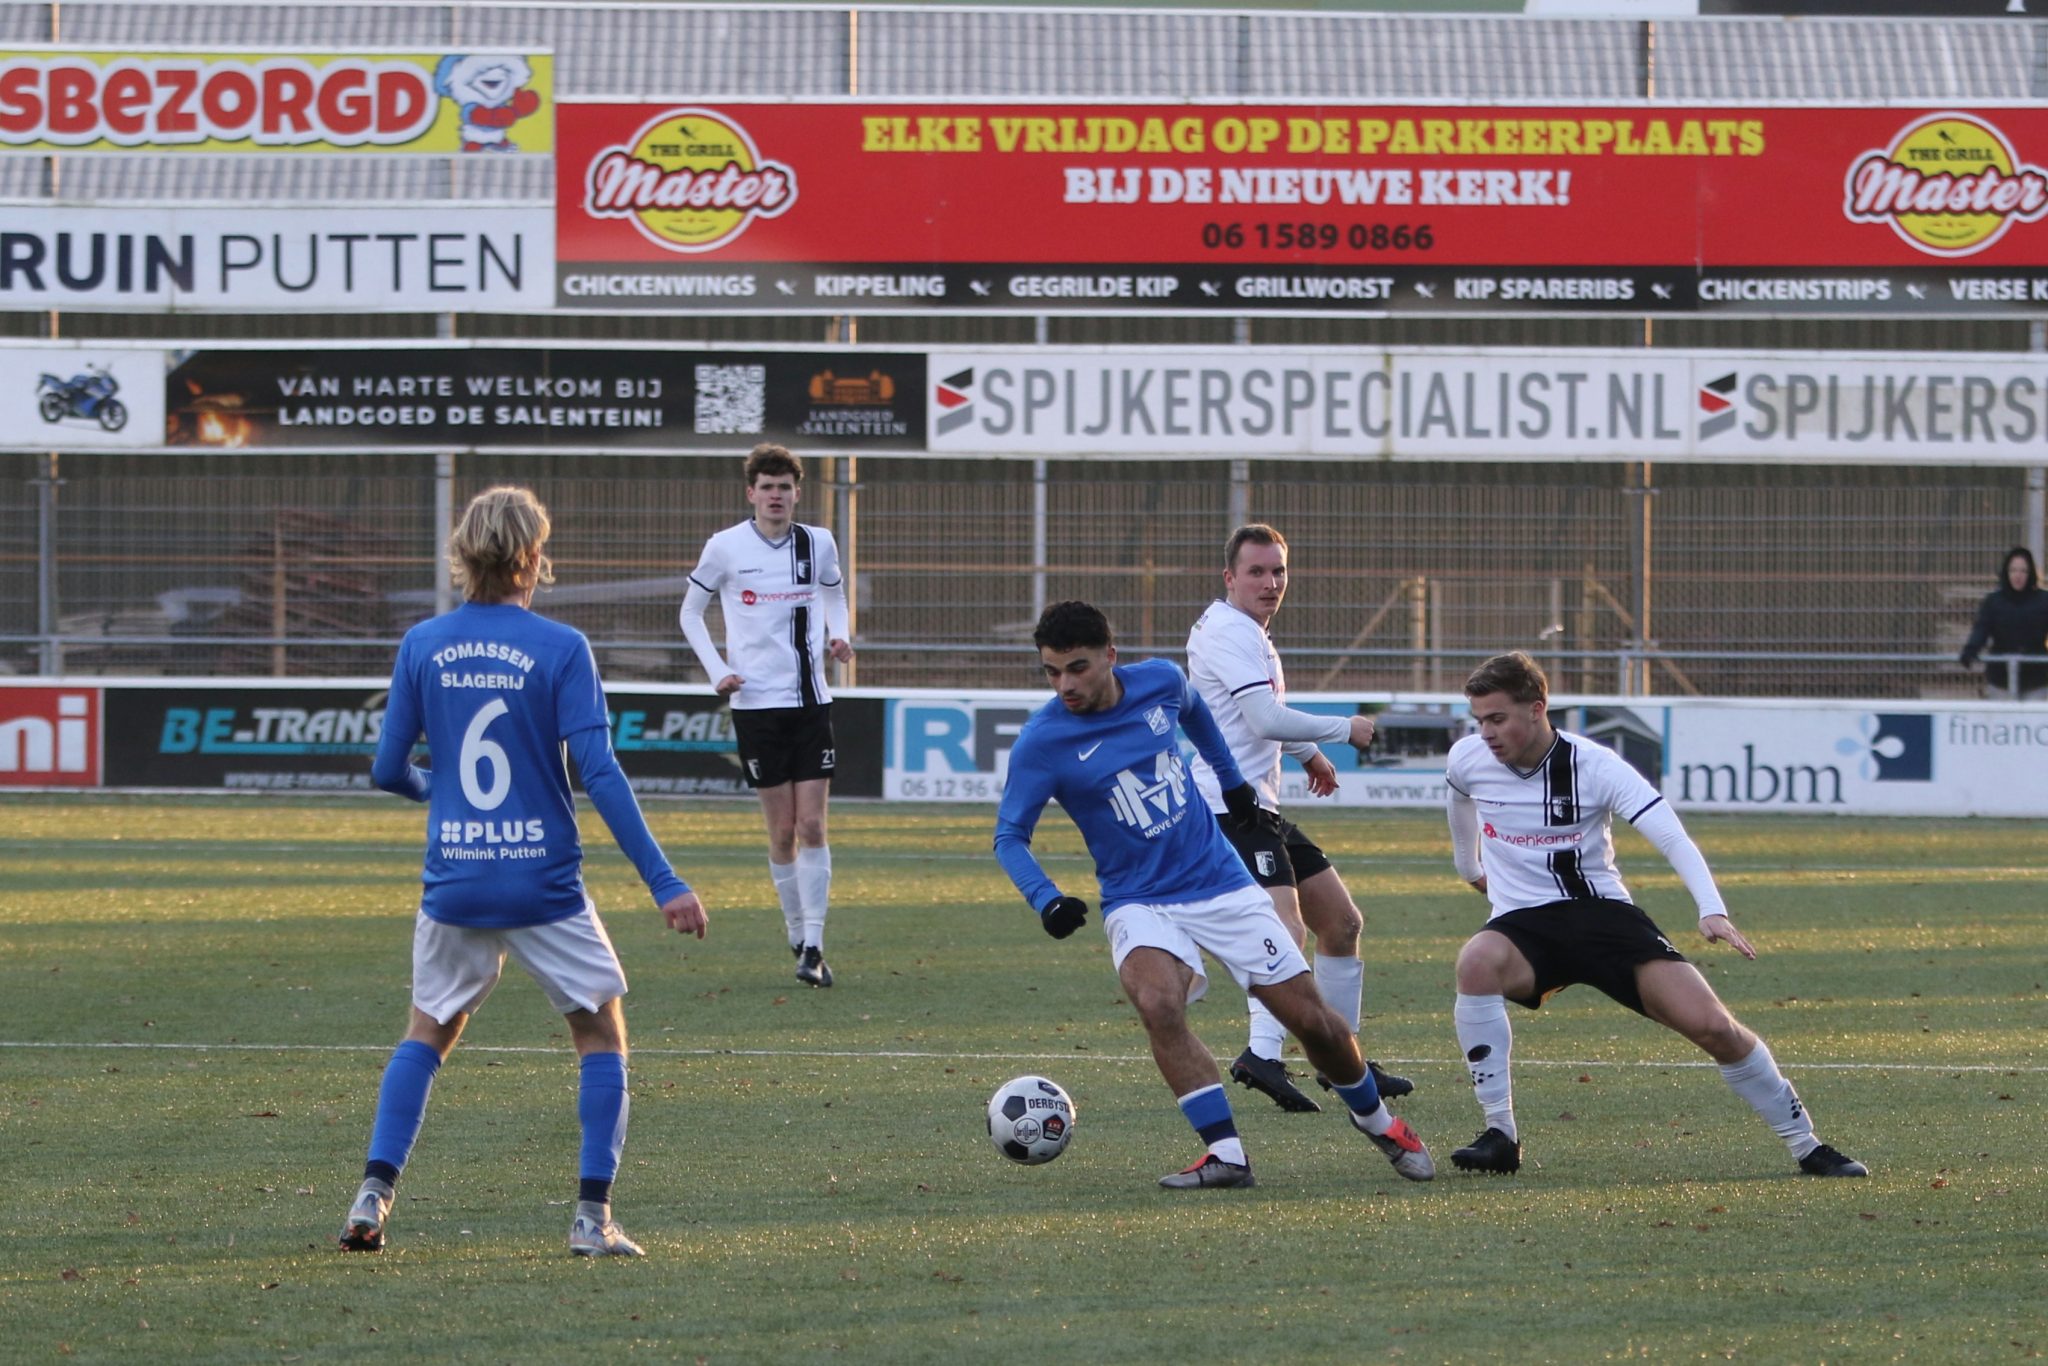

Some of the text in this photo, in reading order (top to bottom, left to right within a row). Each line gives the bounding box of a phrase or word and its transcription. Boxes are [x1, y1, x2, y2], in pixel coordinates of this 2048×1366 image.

[862, 117, 1766, 156] ELKE VRIJDAG OP DE PARKEERPLAATS
[649, 145, 735, 158] THE GRILL
[1908, 149, 1996, 162] THE GRILL
[594, 154, 787, 208] Master
[1063, 167, 1571, 205] BIJ DE NIEUWE KERK!
[1855, 159, 2045, 212] Master
[1203, 223, 1434, 249] 06 1589 0866
[220, 233, 522, 292] PUTTEN
[564, 275, 757, 297] CHICKENWINGS
[815, 276, 945, 297] KIPPELING
[1009, 277, 1178, 298] GEGRILDE KIP
[1235, 277, 1394, 299] GRILLWORST
[1454, 278, 1635, 300] KIP SPARERIBS
[1699, 279, 1891, 300] CHICKENSTRIPS
[1949, 279, 2028, 300] VERSE
[278, 377, 663, 399] VAN HARTE WELKOM BIJ
[981, 369, 1680, 440] SPIJKERSPECIALIST.NL
[278, 407, 663, 427] LANDGOED DE SALENTEIN!
[809, 410, 894, 421] LANDGOED
[803, 421, 907, 436] SALENTEIN
[433, 643, 535, 673] TOMASSEN
[441, 674, 524, 690] SLAGERIJ
[459, 698, 511, 811] 6
[822, 749, 836, 764] 21
[1680, 744, 1846, 802] mbm
[902, 779, 927, 797] 06
[935, 779, 954, 798] 12
[962, 779, 987, 798] 96
[465, 820, 544, 843] PLUS
[1144, 819, 1172, 839] MOVE
[1501, 832, 1583, 846] wehkamp
[441, 847, 546, 860] Wilmink Putten
[1264, 938, 1277, 956] 8
